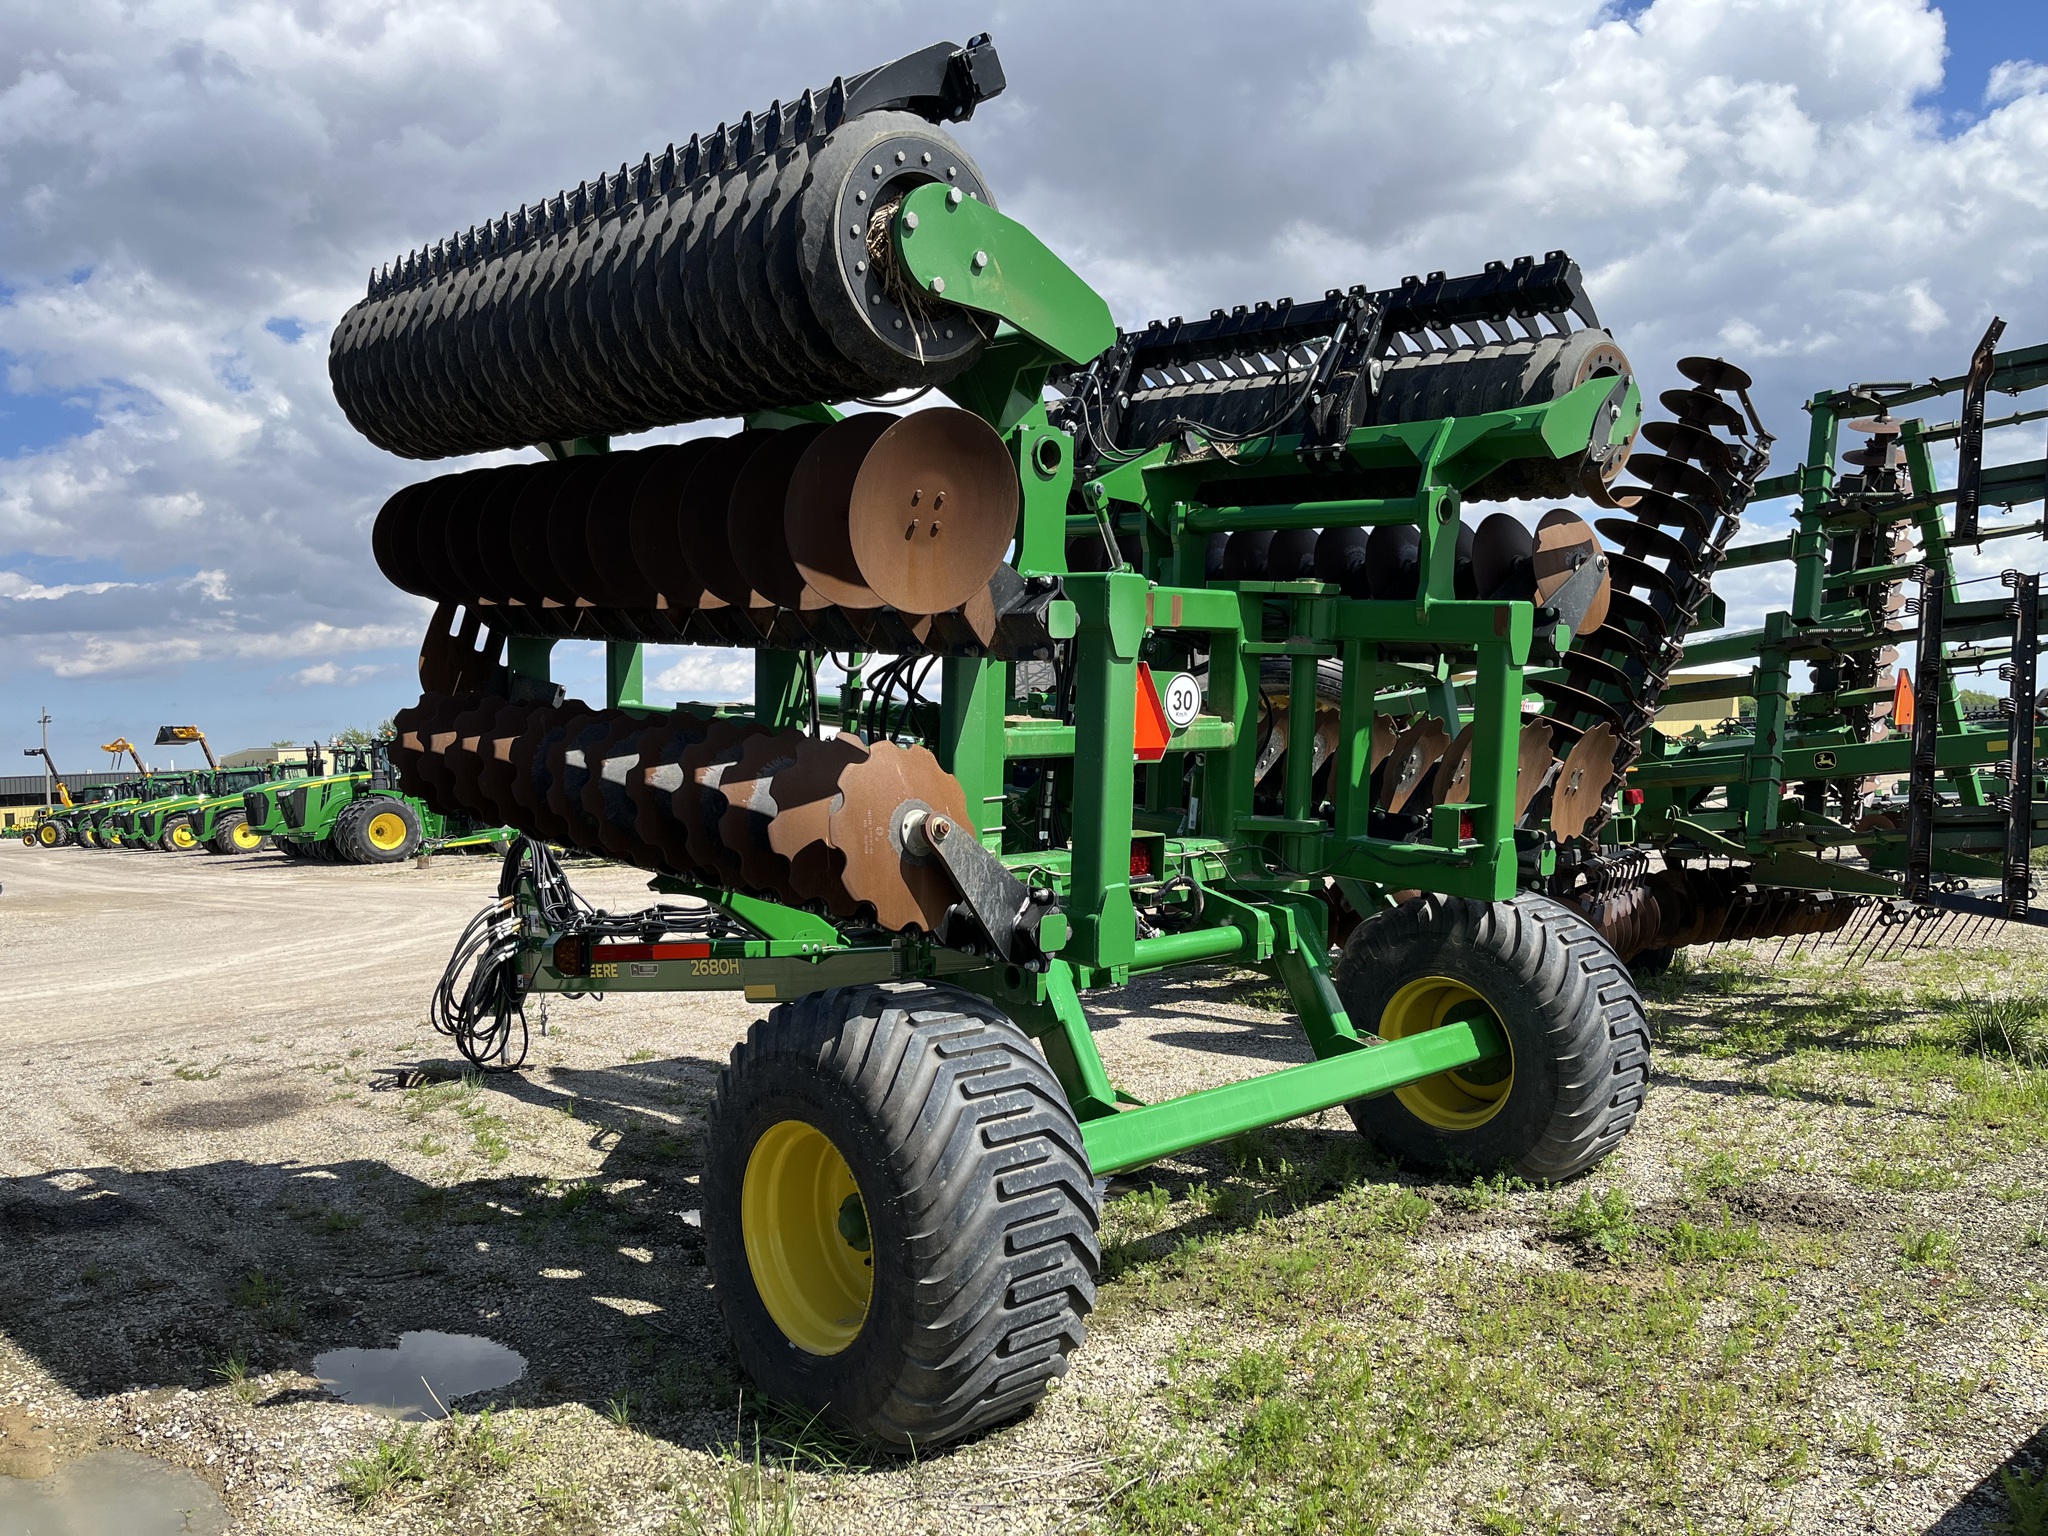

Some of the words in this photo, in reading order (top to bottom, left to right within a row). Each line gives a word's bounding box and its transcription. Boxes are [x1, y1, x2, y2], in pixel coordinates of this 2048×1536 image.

[1173, 690, 1193, 710] 30
[590, 963, 619, 978] EERE
[690, 959, 740, 976] 2680H
